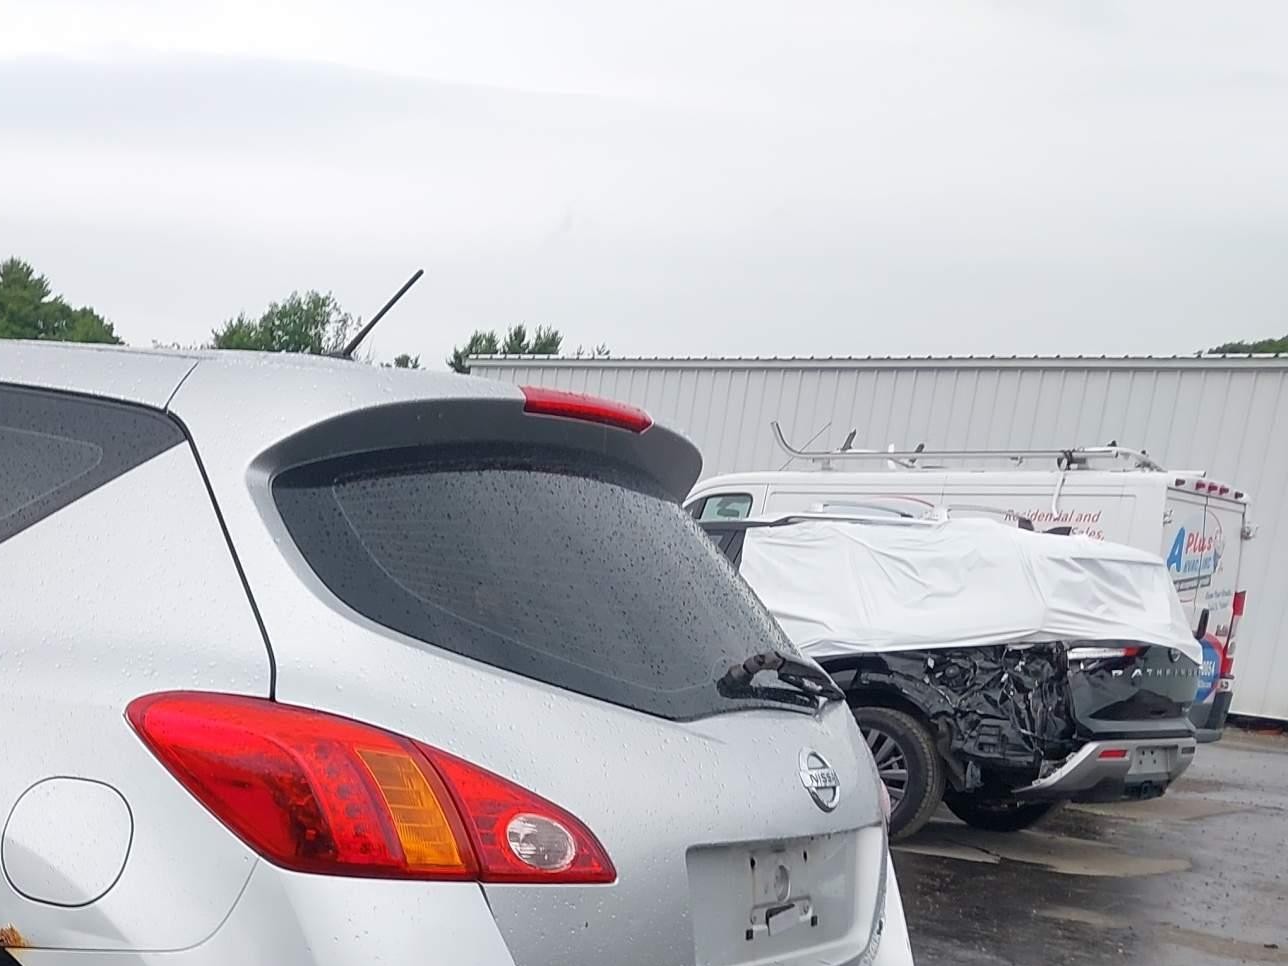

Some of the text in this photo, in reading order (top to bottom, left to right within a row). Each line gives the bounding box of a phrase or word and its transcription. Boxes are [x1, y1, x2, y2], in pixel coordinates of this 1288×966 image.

[1075, 509, 1102, 522] and
[1166, 526, 1213, 573] A Plus
